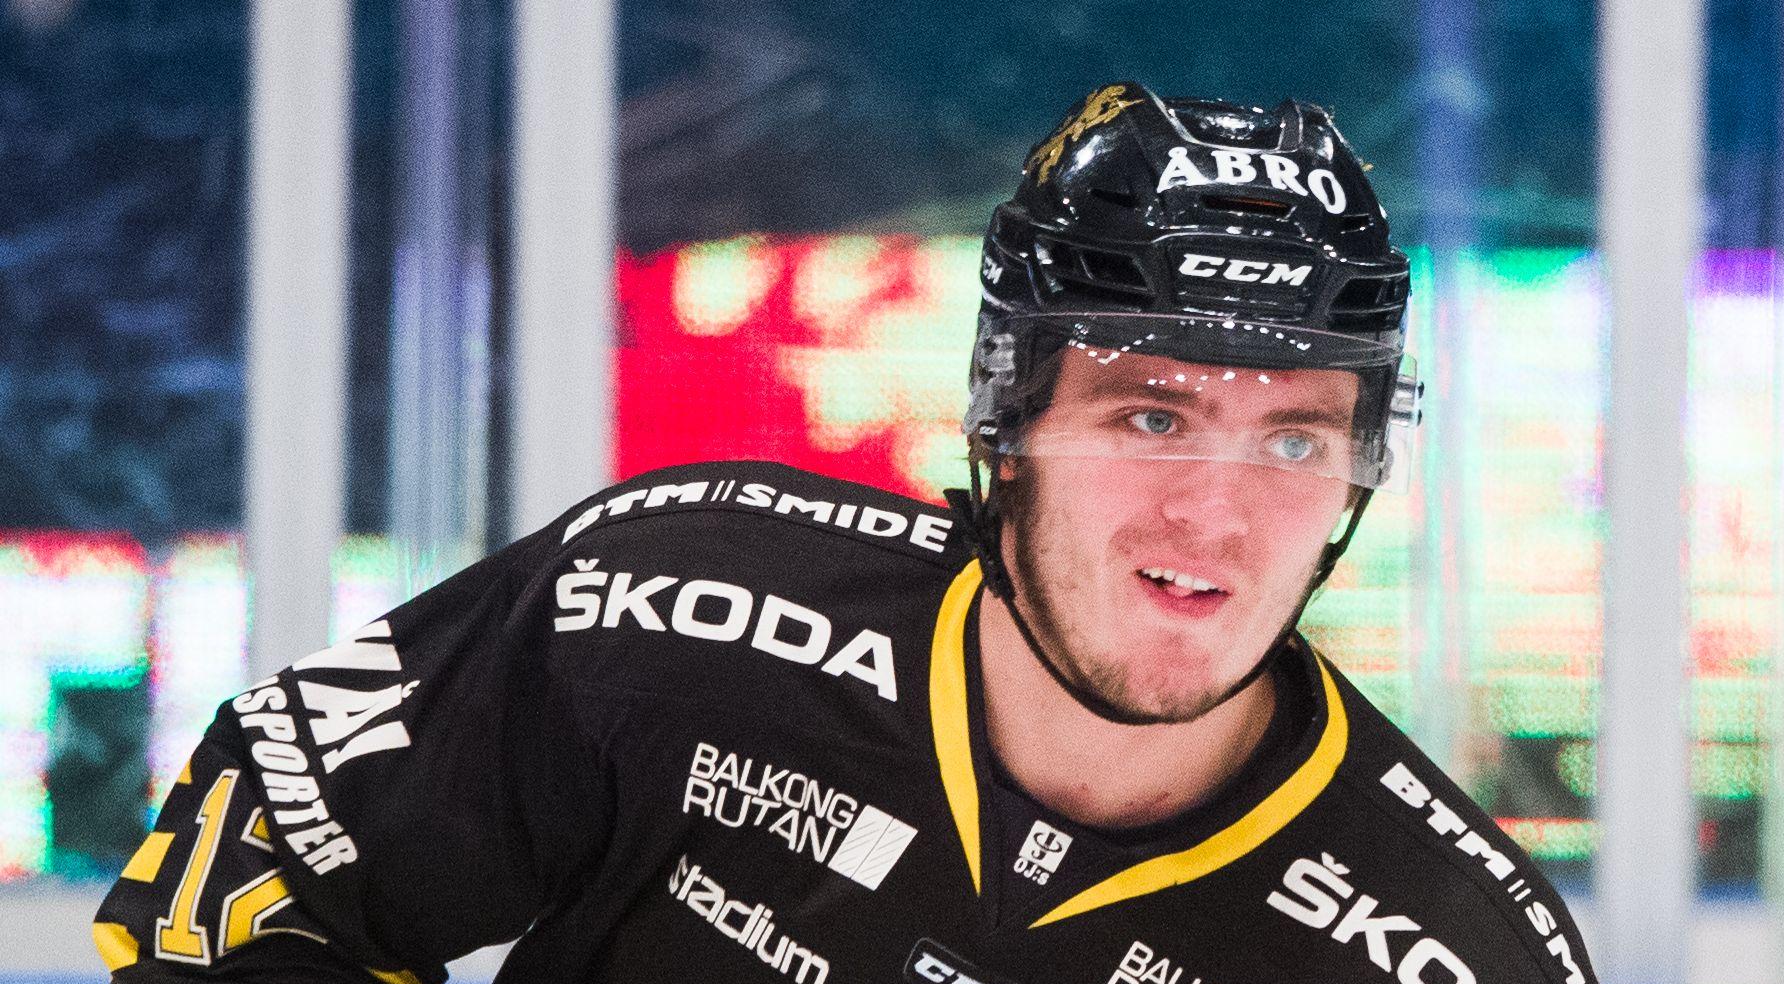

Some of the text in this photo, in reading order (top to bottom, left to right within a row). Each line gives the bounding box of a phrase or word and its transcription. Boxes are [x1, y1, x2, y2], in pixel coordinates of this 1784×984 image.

[1157, 146, 1347, 214] ÅBRO
[1178, 253, 1313, 287] CCM
[555, 558, 898, 702] ŠKODA
[232, 675, 358, 876] SPORTER
[689, 741, 858, 830] BALKONG
[683, 776, 837, 864] RUTAN
